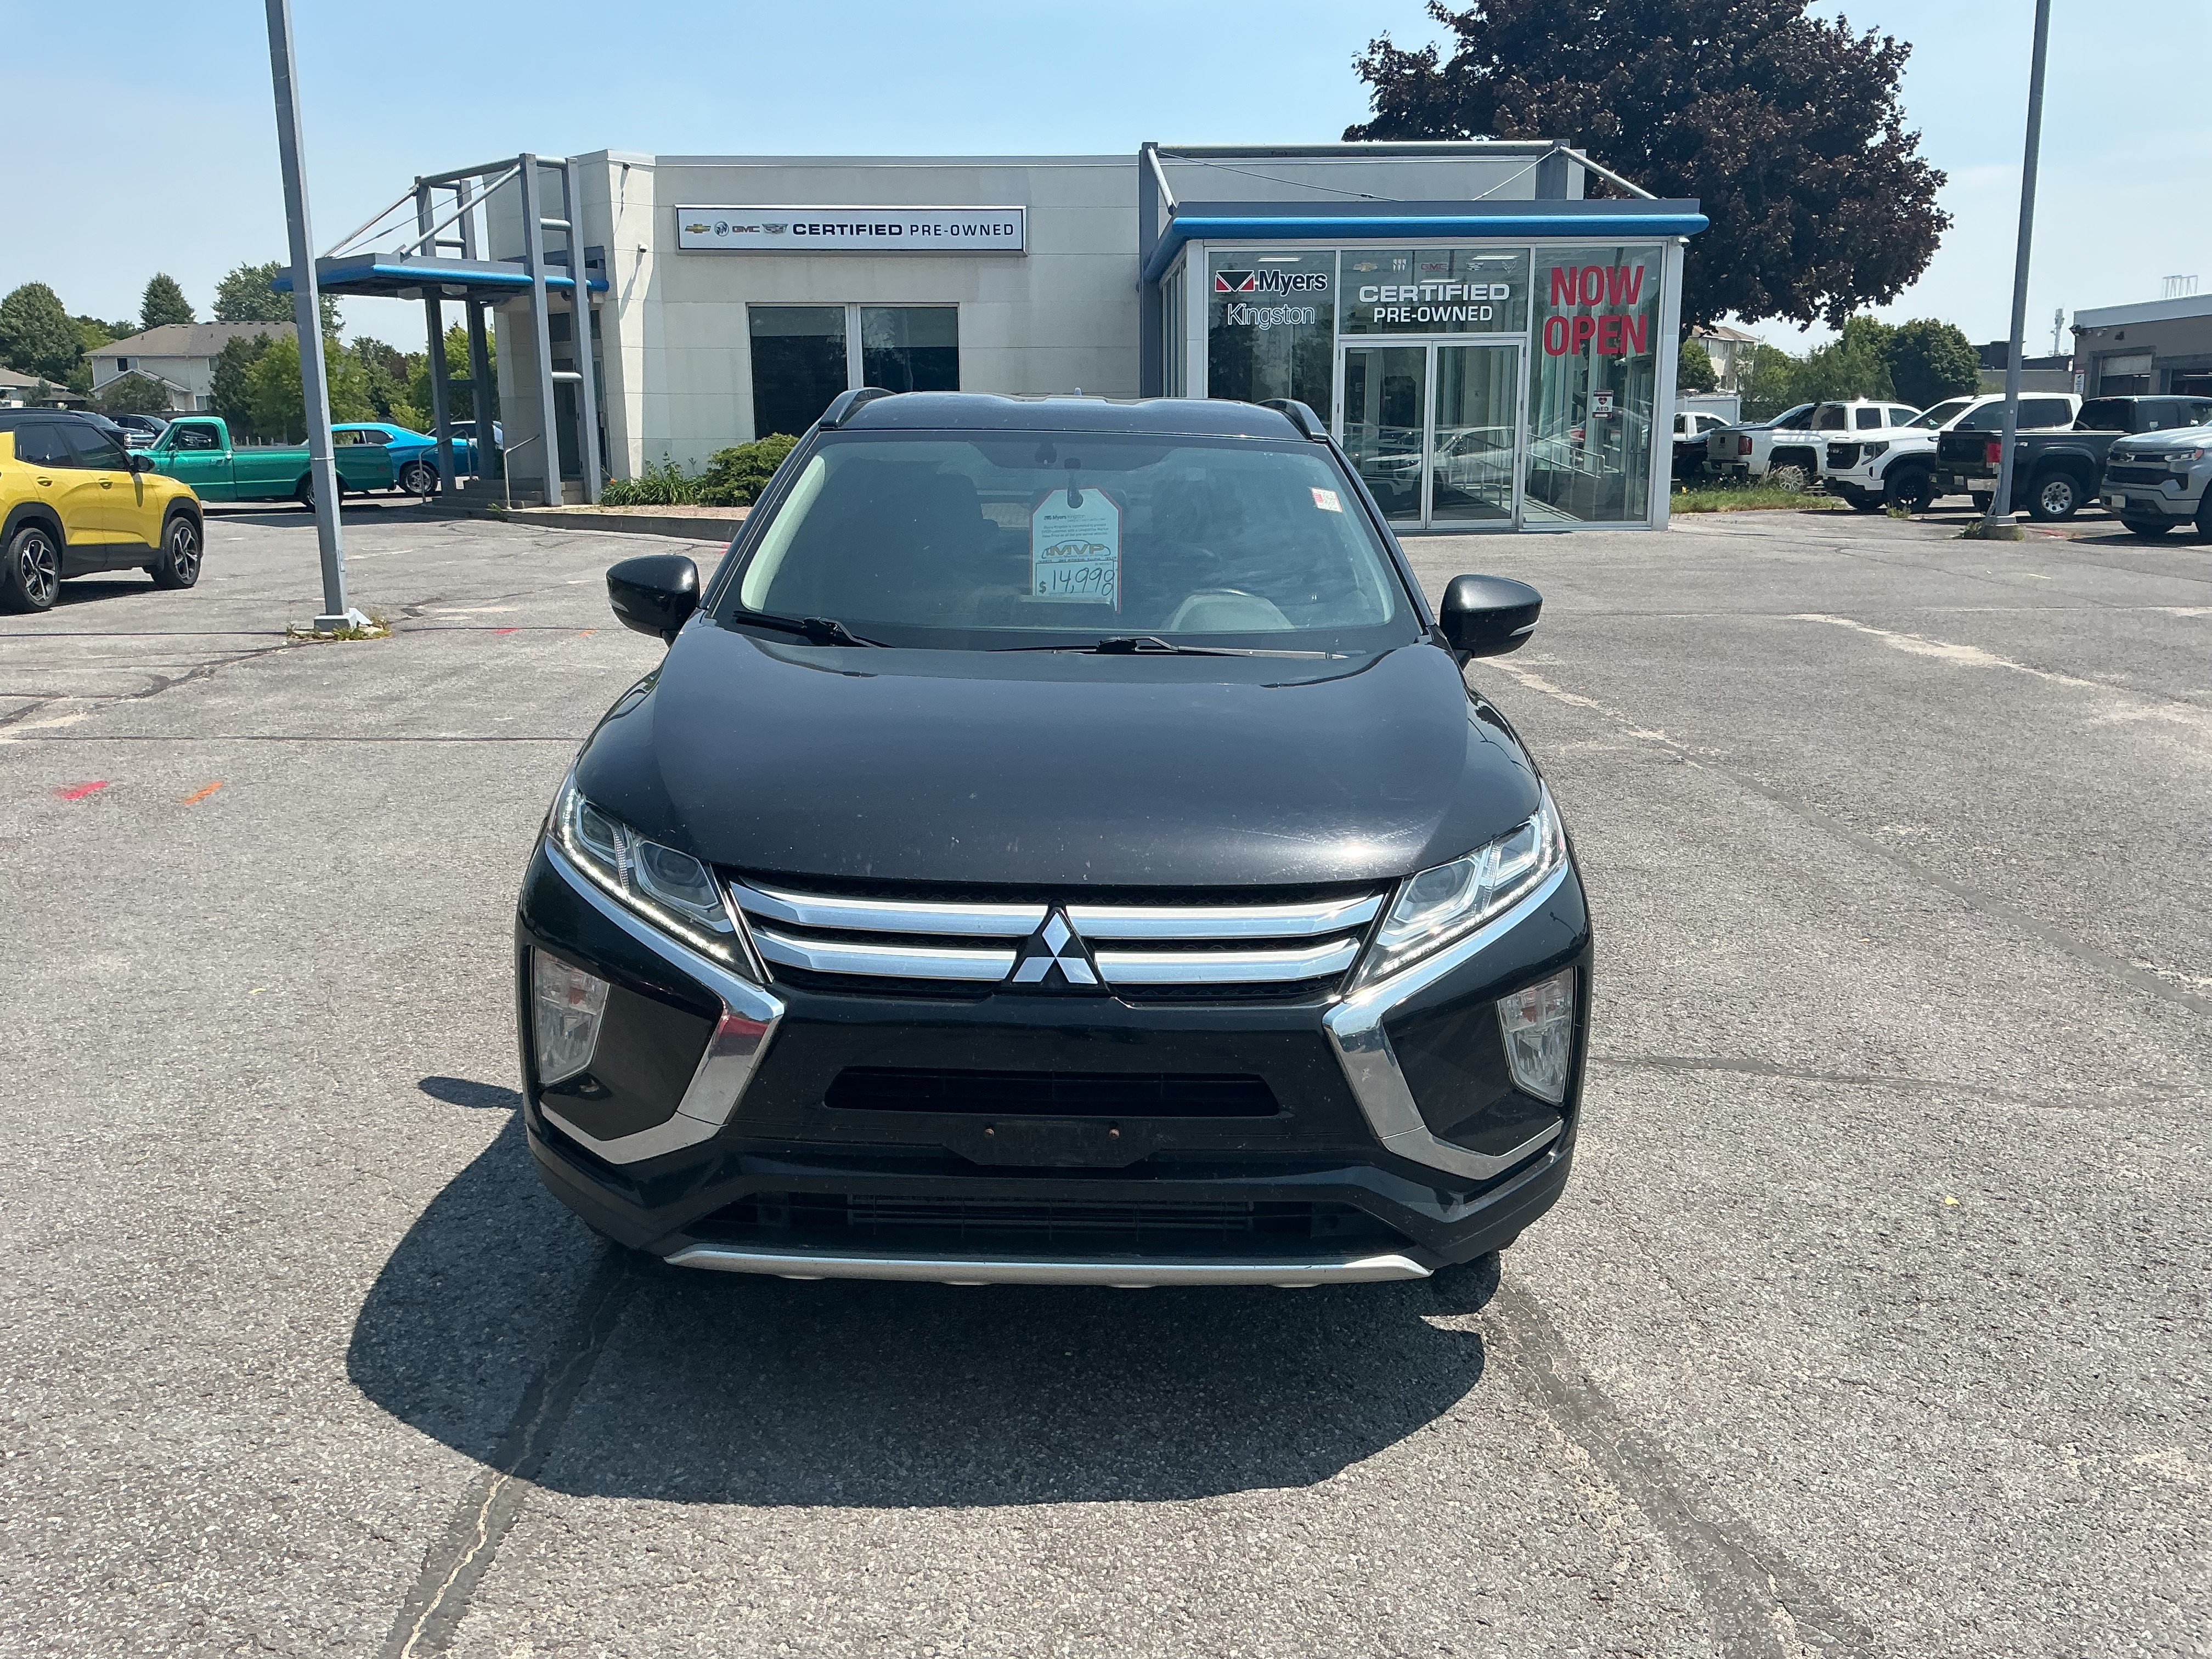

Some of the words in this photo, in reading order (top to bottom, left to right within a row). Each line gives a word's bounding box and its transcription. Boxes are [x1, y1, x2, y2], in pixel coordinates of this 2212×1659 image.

[792, 223, 903, 236] CERTIFIED
[909, 224, 1014, 236] PRE-OWNED
[1420, 262, 1449, 271] GMC
[1258, 269, 1328, 297] Myers
[1550, 265, 1645, 306] NOW
[1359, 284, 1510, 302] CERTIFIED
[1227, 303, 1315, 330] Kingston
[1374, 306, 1493, 323] PRE-OWNED
[1544, 314, 1647, 356] OPEN
[1047, 544, 1104, 556] MVP
